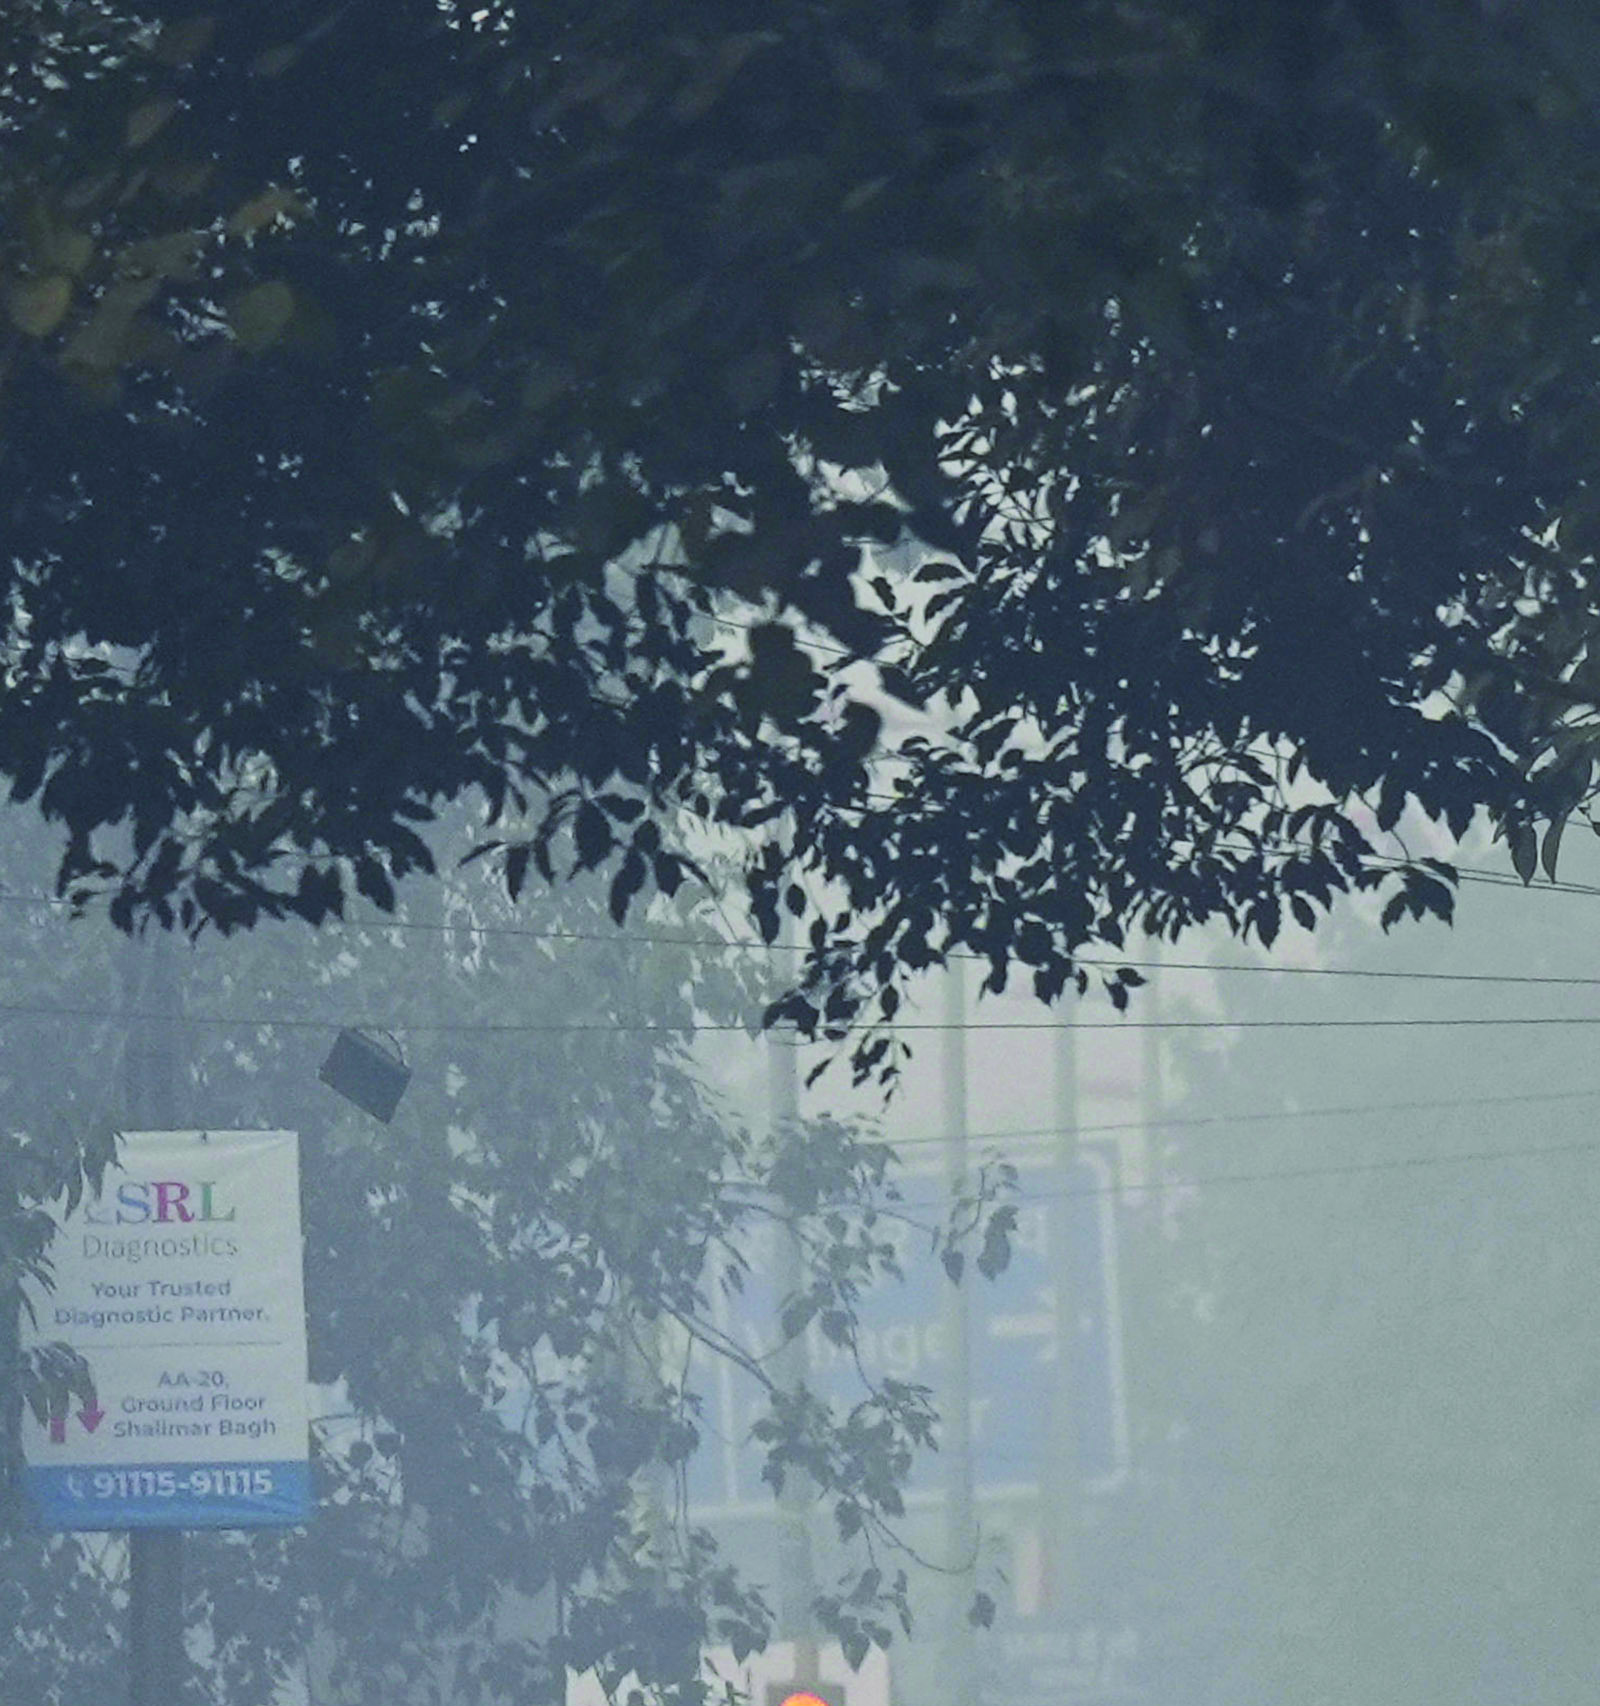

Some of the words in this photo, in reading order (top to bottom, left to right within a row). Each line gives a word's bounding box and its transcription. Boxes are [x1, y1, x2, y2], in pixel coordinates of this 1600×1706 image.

[114, 1181, 236, 1225] SRL
[82, 1233, 240, 1263] Diagnostics
[91, 1282, 141, 1299] Your
[147, 1280, 232, 1297] Trusted
[54, 1306, 174, 1329] Diagnostic
[180, 1305, 271, 1324] Partner.
[120, 1394, 204, 1414] Ground
[211, 1394, 268, 1412] Floor
[113, 1421, 212, 1438] Shalimar
[219, 1418, 277, 1439] Bagh
[93, 1468, 274, 1499] 91115-91115
